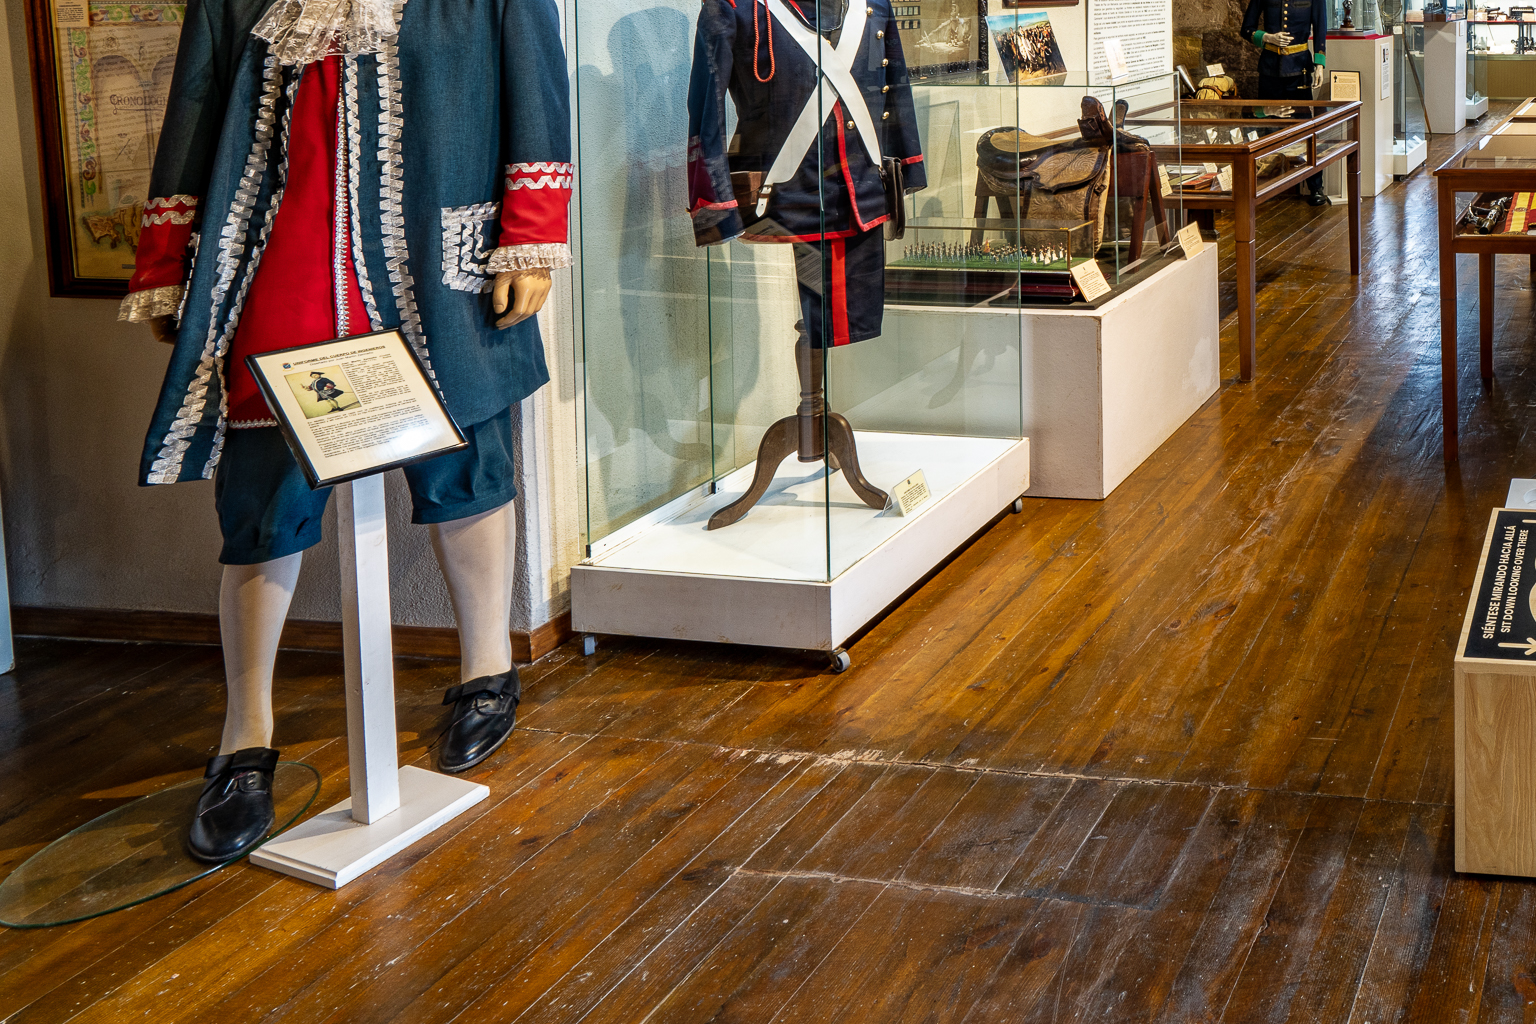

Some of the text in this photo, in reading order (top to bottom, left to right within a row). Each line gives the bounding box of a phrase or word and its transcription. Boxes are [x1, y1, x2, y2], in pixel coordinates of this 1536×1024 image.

[329, 351, 349, 359] CUERPO
[1481, 525, 1517, 639] SIÉNTESE MIRANDO HACIA ALLÁ
[1500, 528, 1530, 634] SIT DOWN LOOKING OVER THERE
